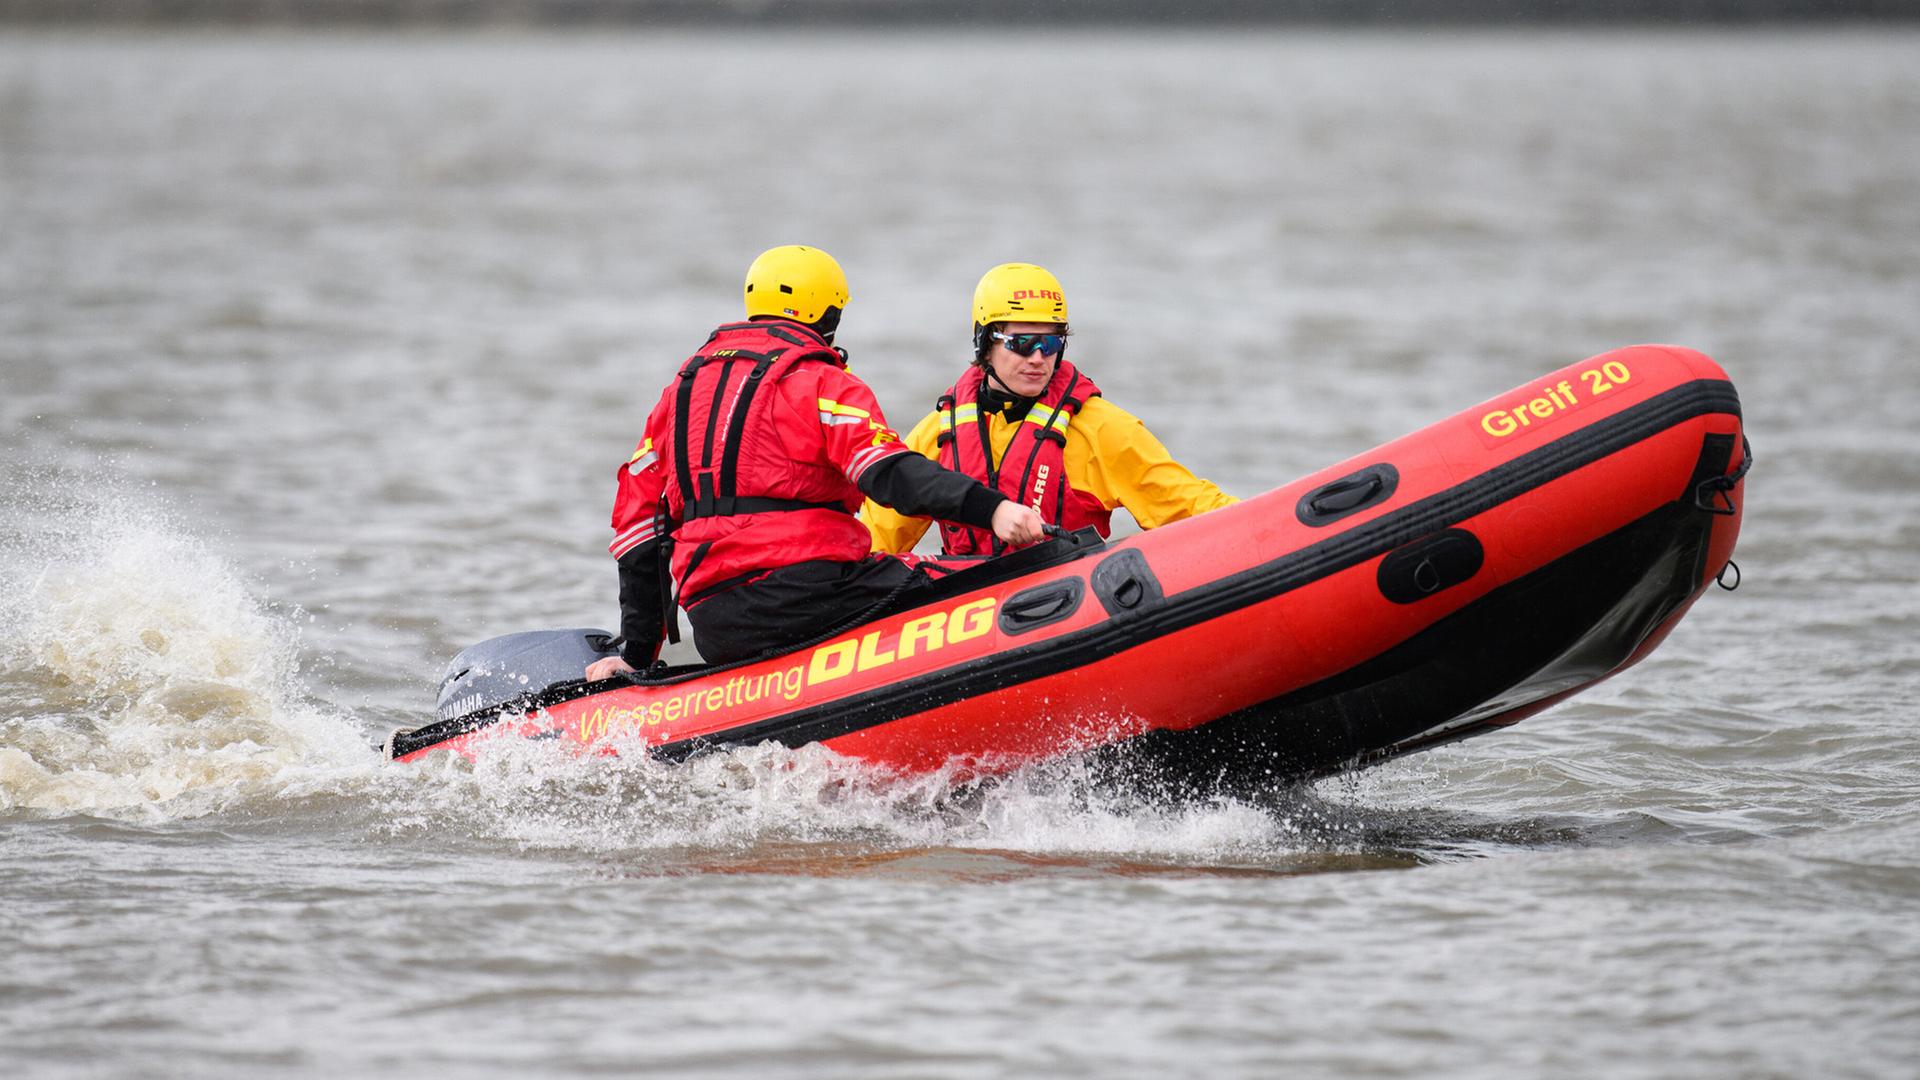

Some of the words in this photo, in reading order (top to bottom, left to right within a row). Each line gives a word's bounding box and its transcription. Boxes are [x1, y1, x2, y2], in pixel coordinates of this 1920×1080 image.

[1013, 289, 1062, 301] DLRG
[1481, 380, 1578, 437] Greif
[1580, 361, 1631, 396] 20
[807, 597, 996, 686] DLRG
